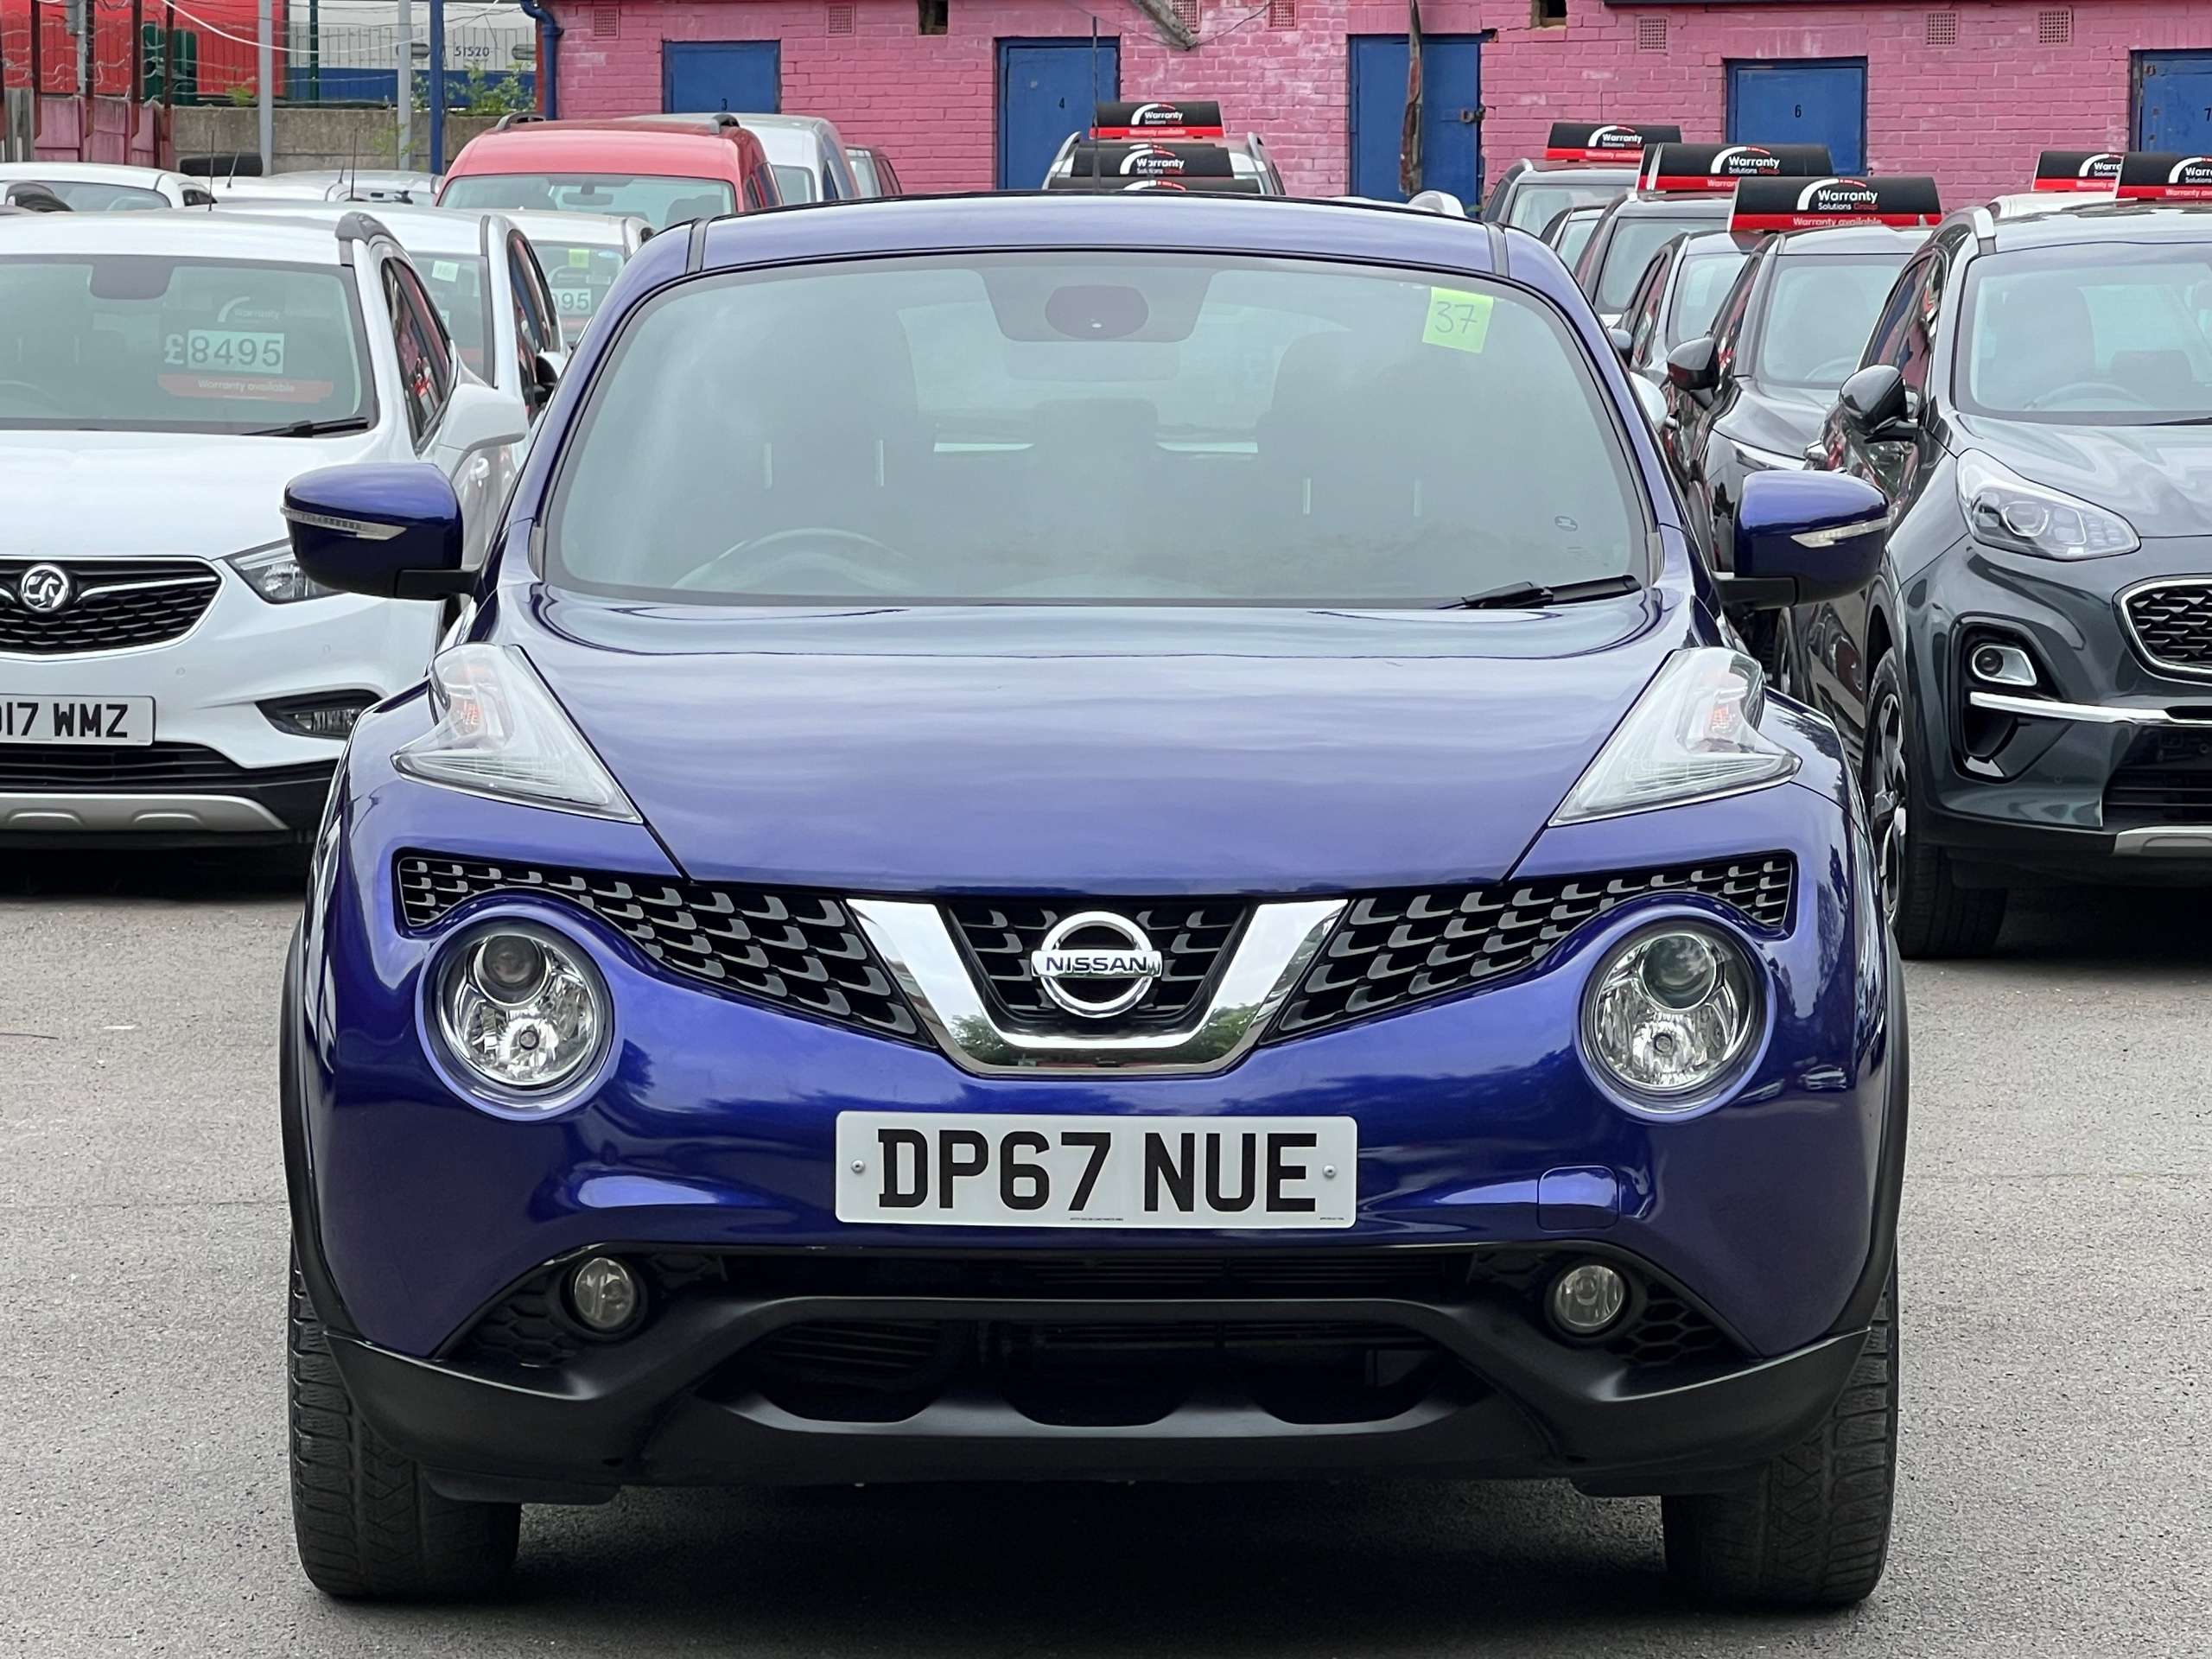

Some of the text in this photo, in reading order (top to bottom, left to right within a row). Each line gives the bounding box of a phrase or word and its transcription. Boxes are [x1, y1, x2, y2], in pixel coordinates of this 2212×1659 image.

[454, 46, 490, 57] 51520
[1058, 96, 1065, 109] 4
[1144, 111, 1183, 121] Warranty
[1795, 104, 1802, 118] 6
[2203, 107, 2212, 122] 7
[1602, 134, 1643, 144] Warranty
[1136, 158, 1185, 169] Warranty
[1728, 156, 1780, 169] Warranty
[1818, 189, 1878, 205] Warranty
[1793, 217, 1836, 226] Warranty
[552, 292, 589, 311] 95
[1435, 301, 1478, 334] 37
[198, 378, 245, 392] Warranty
[0, 702, 129, 738] 17 WMZ
[1046, 957, 1147, 971] NISSAN
[878, 1128, 1317, 1212] DP67 NUE
